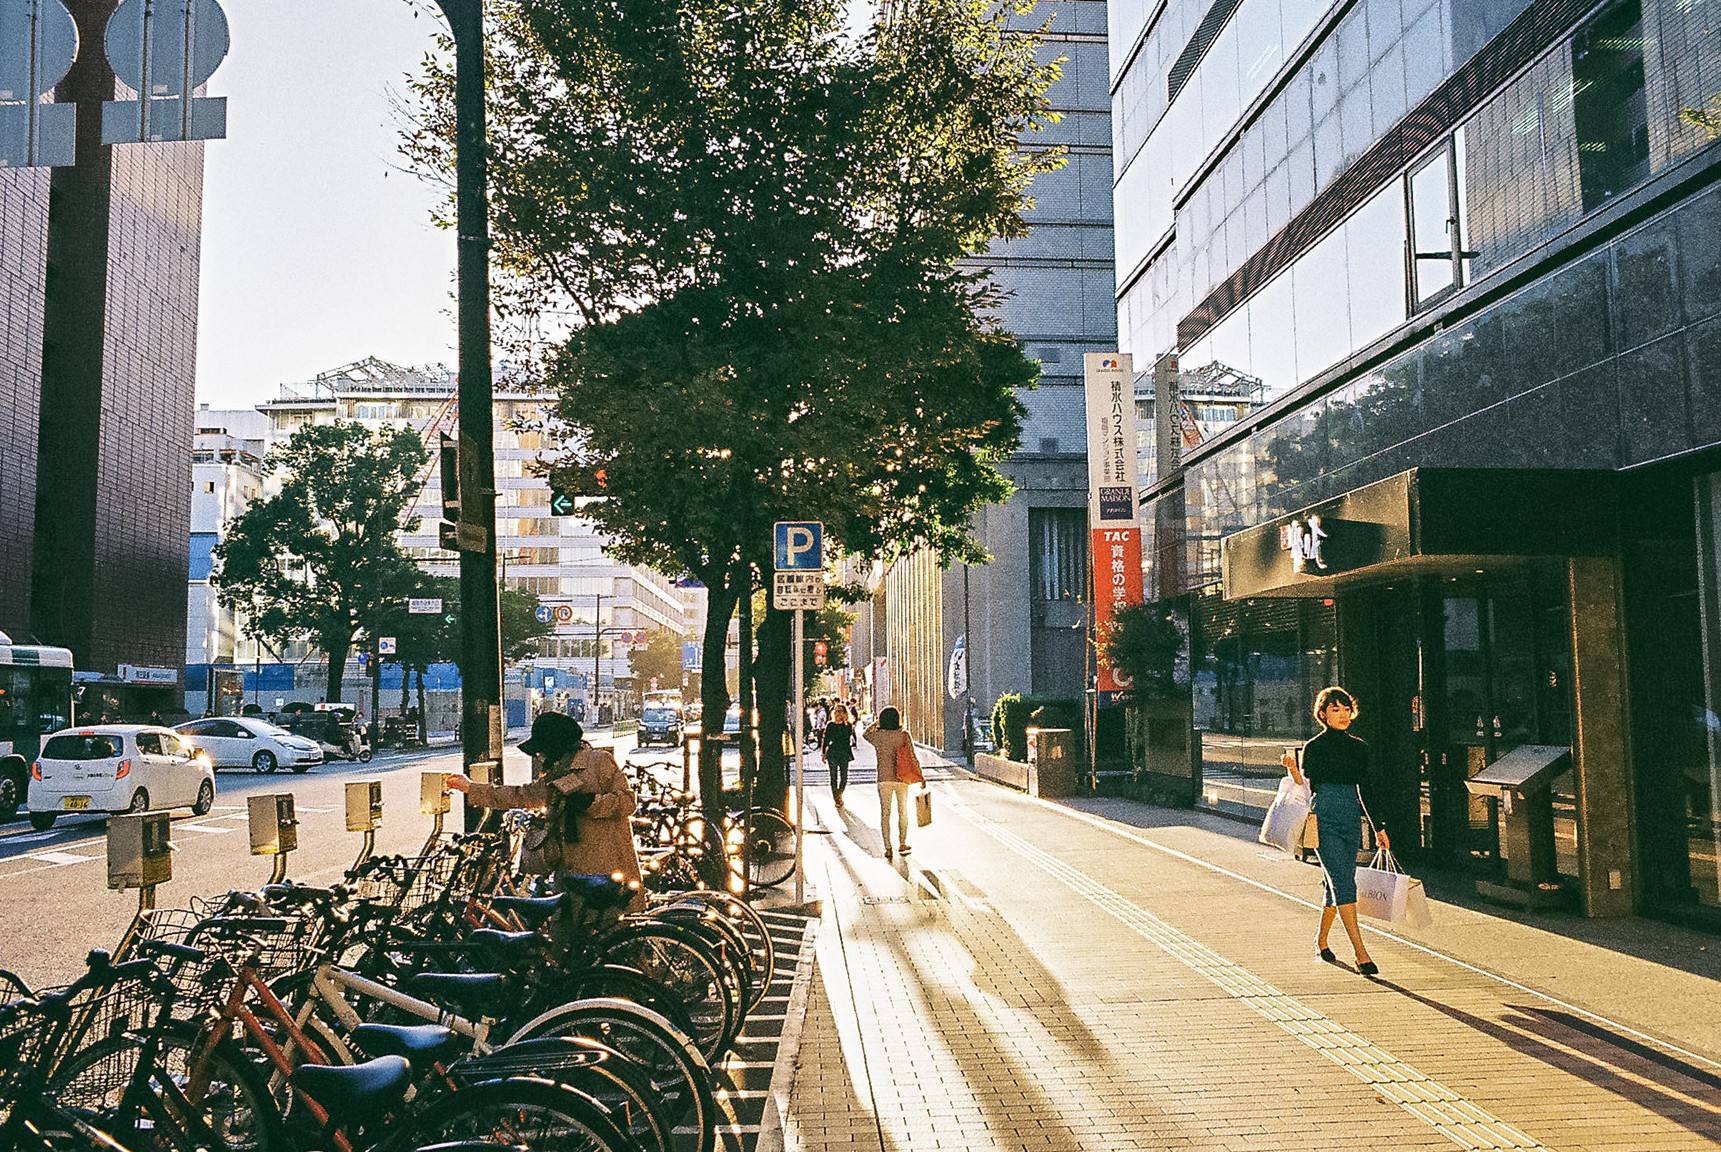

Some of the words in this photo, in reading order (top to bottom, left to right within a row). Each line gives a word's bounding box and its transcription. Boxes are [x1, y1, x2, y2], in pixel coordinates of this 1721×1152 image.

[1110, 380, 1126, 483] 積水ハウス株式会社
[1100, 495, 1132, 503] MAISON
[1103, 530, 1130, 542] TAC
[787, 527, 814, 566] P
[780, 598, 817, 606] ここまで
